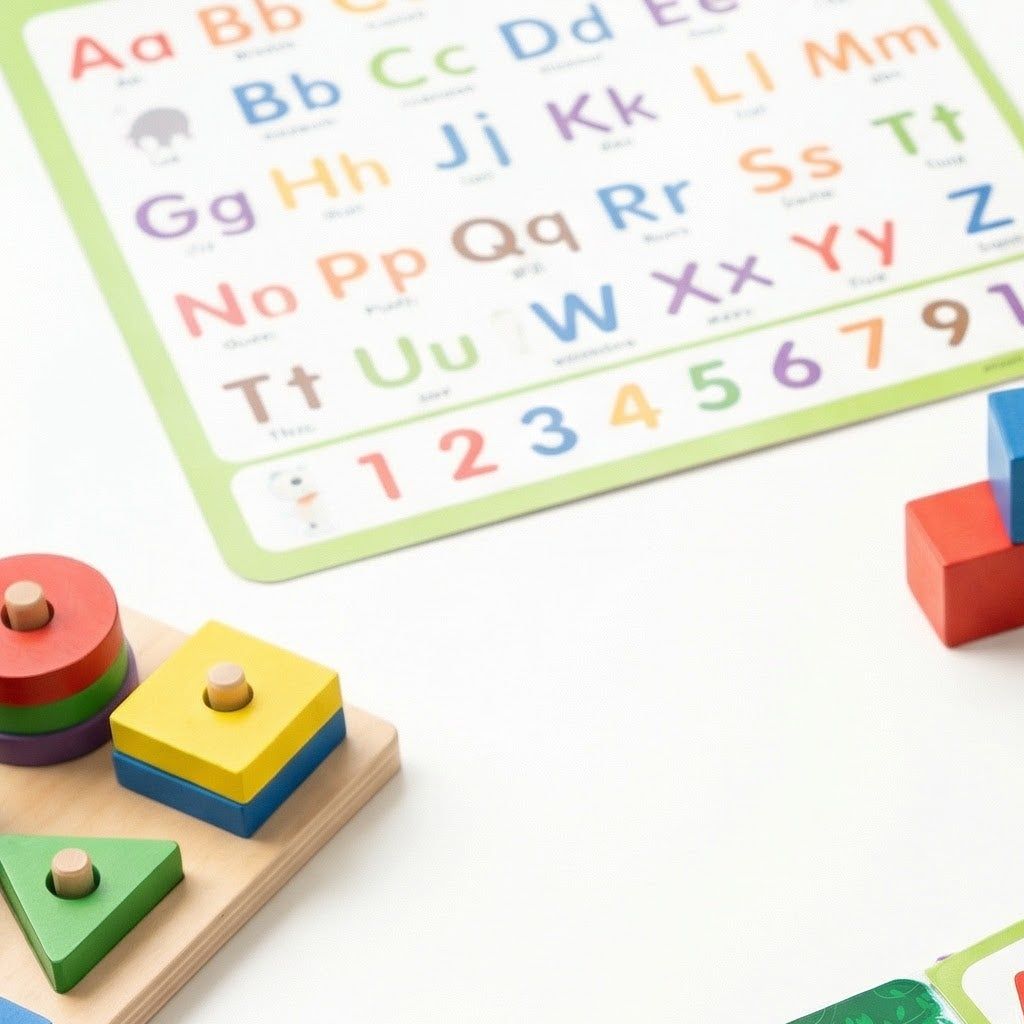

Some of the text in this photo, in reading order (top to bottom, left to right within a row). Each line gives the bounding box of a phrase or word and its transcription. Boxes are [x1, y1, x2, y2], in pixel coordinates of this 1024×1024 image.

[71, 0, 303, 80] Aa Bb
[135, 191, 255, 239] Gg
[270, 153, 391, 210] Hh
[546, 88, 656, 141] Kk
[804, 23, 940, 79] Mm
[232, 74, 341, 125] Bb
[368, 45, 476, 90] Cc
[499, 3, 614, 61] Dd
[175, 104, 965, 339] No Pp Qq Rr Ss Tt
[222, 184, 1014, 424] Tt Uu W Xx Yy Z
[358, 453, 401, 500] 1
[439, 429, 498, 481] 2
[521, 407, 578, 456] 3
[610, 383, 661, 429] 4
[689, 360, 741, 411] 5
[773, 341, 822, 389] 6
[839, 317, 884, 369] 7
[921, 299, 970, 347] 9
